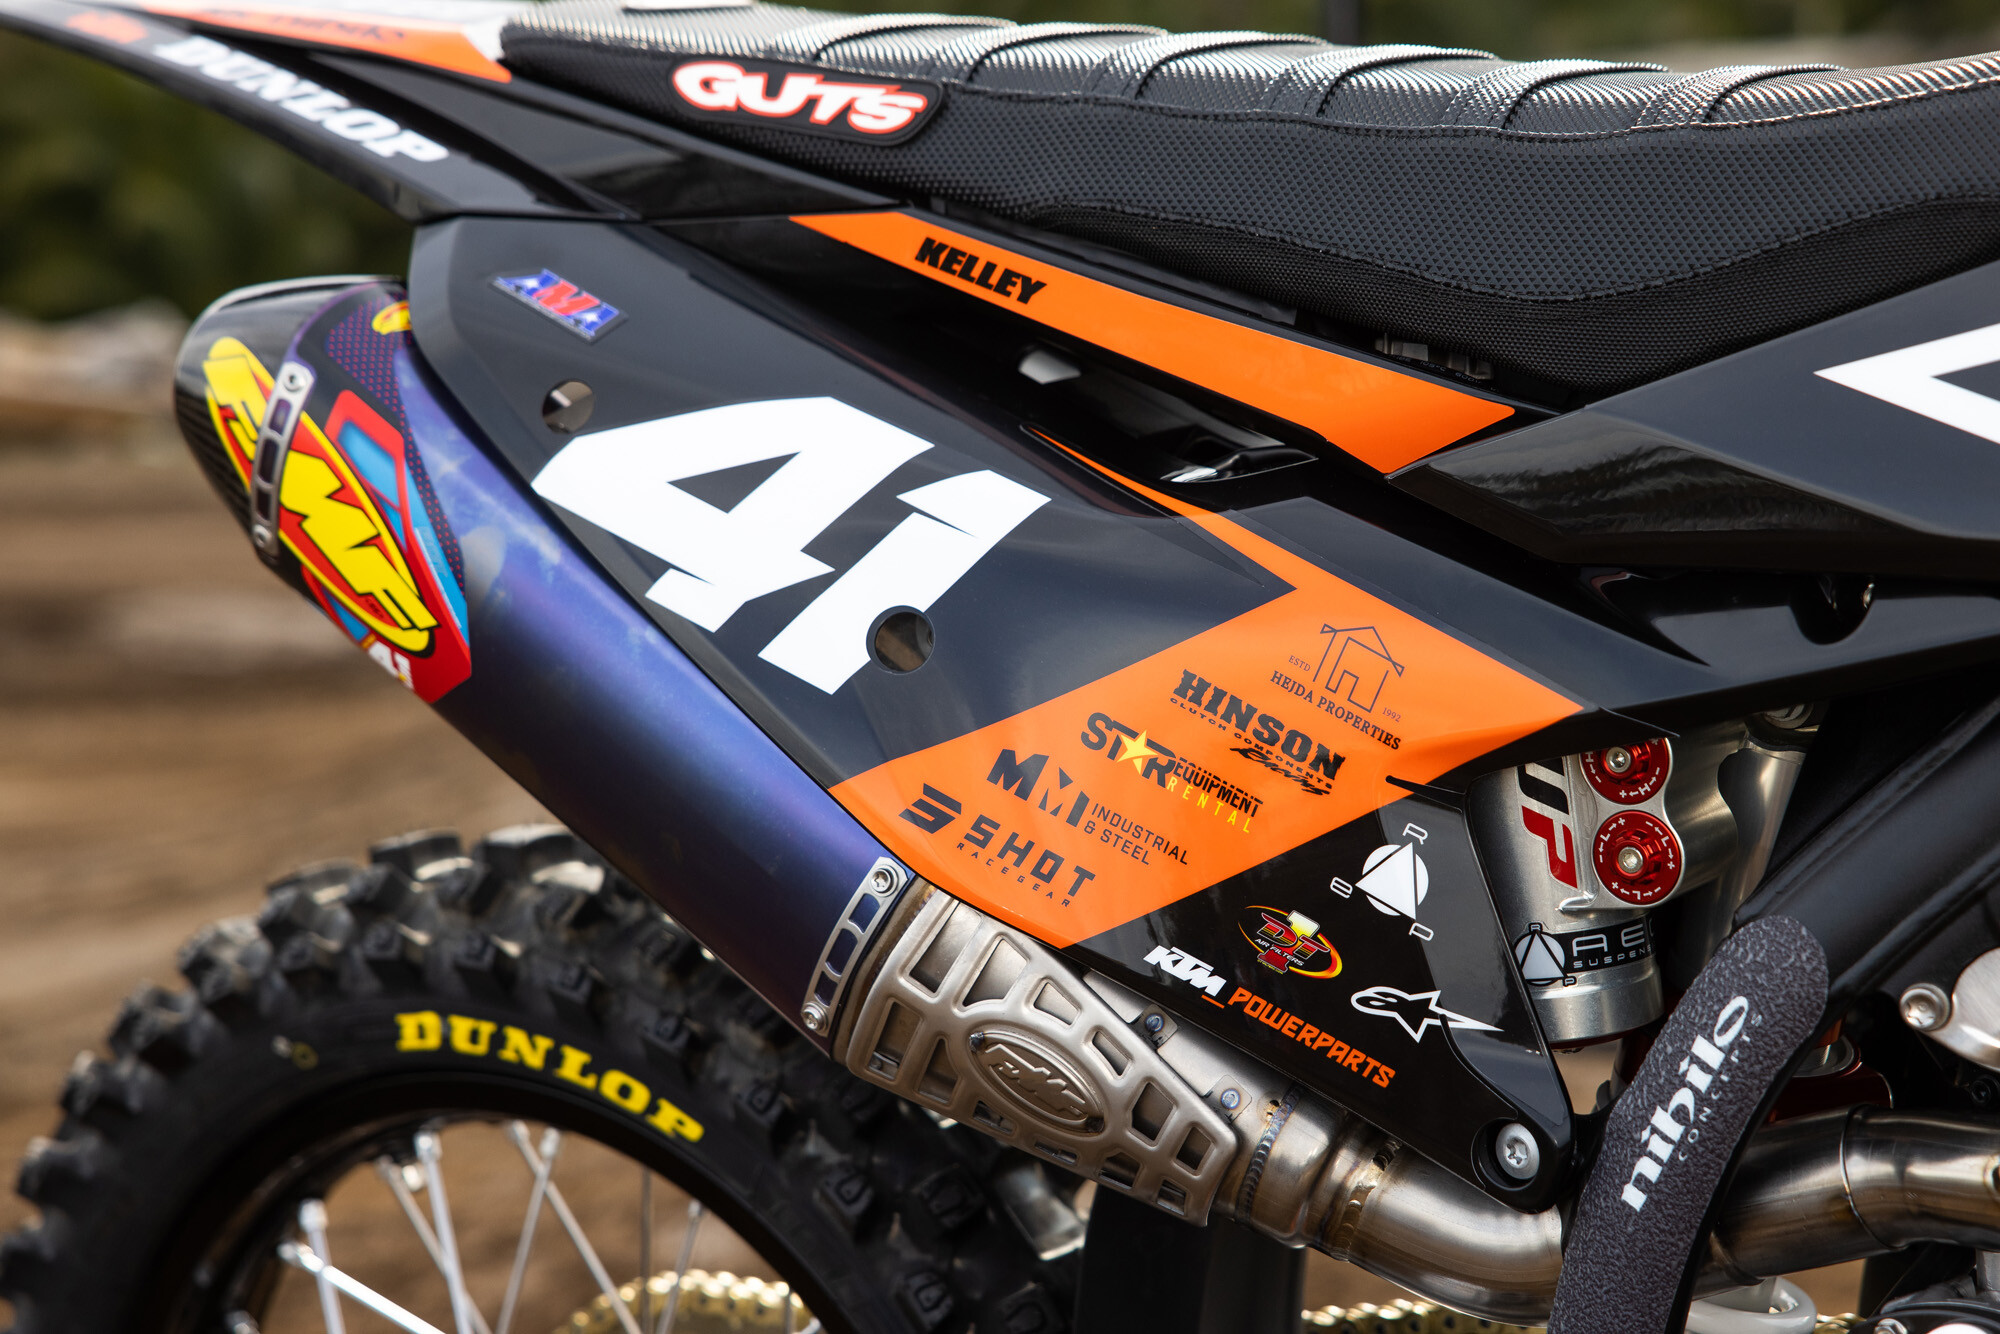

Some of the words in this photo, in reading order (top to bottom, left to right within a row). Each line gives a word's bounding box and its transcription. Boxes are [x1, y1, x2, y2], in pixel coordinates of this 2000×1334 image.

[153, 35, 449, 163] DUNLOP
[672, 61, 928, 134] GUTS
[496, 268, 620, 337] AMA
[914, 236, 1048, 305] KELLEY
[530, 396, 1053, 695] 41
[1288, 655, 1311, 672] ESTD
[1169, 697, 1227, 732] CLUTCH
[1233, 732, 1333, 790] COMPONENTS
[1173, 668, 1346, 781] HINSON
[1269, 670, 1313, 704] HEJDA
[1316, 695, 1402, 750] PROPERTIES
[1382, 707, 1402, 723] 1992
[1166, 775, 1251, 834] RENTAL
[1173, 756, 1264, 818] EQUIPMENT
[963, 813, 1097, 898] SHOT
[1083, 820, 1096, 835] &
[1099, 828, 1150, 866] STEEL
[1091, 802, 1188, 866] INDUSTRIAL
[1142, 944, 1228, 997] KTM
[1254, 938, 1271, 948] AIR
[1270, 944, 1305, 967] FILTERS
[395, 1009, 705, 1144] DUNLOP
[1678, 1013, 1763, 1162] CONCEPTS
